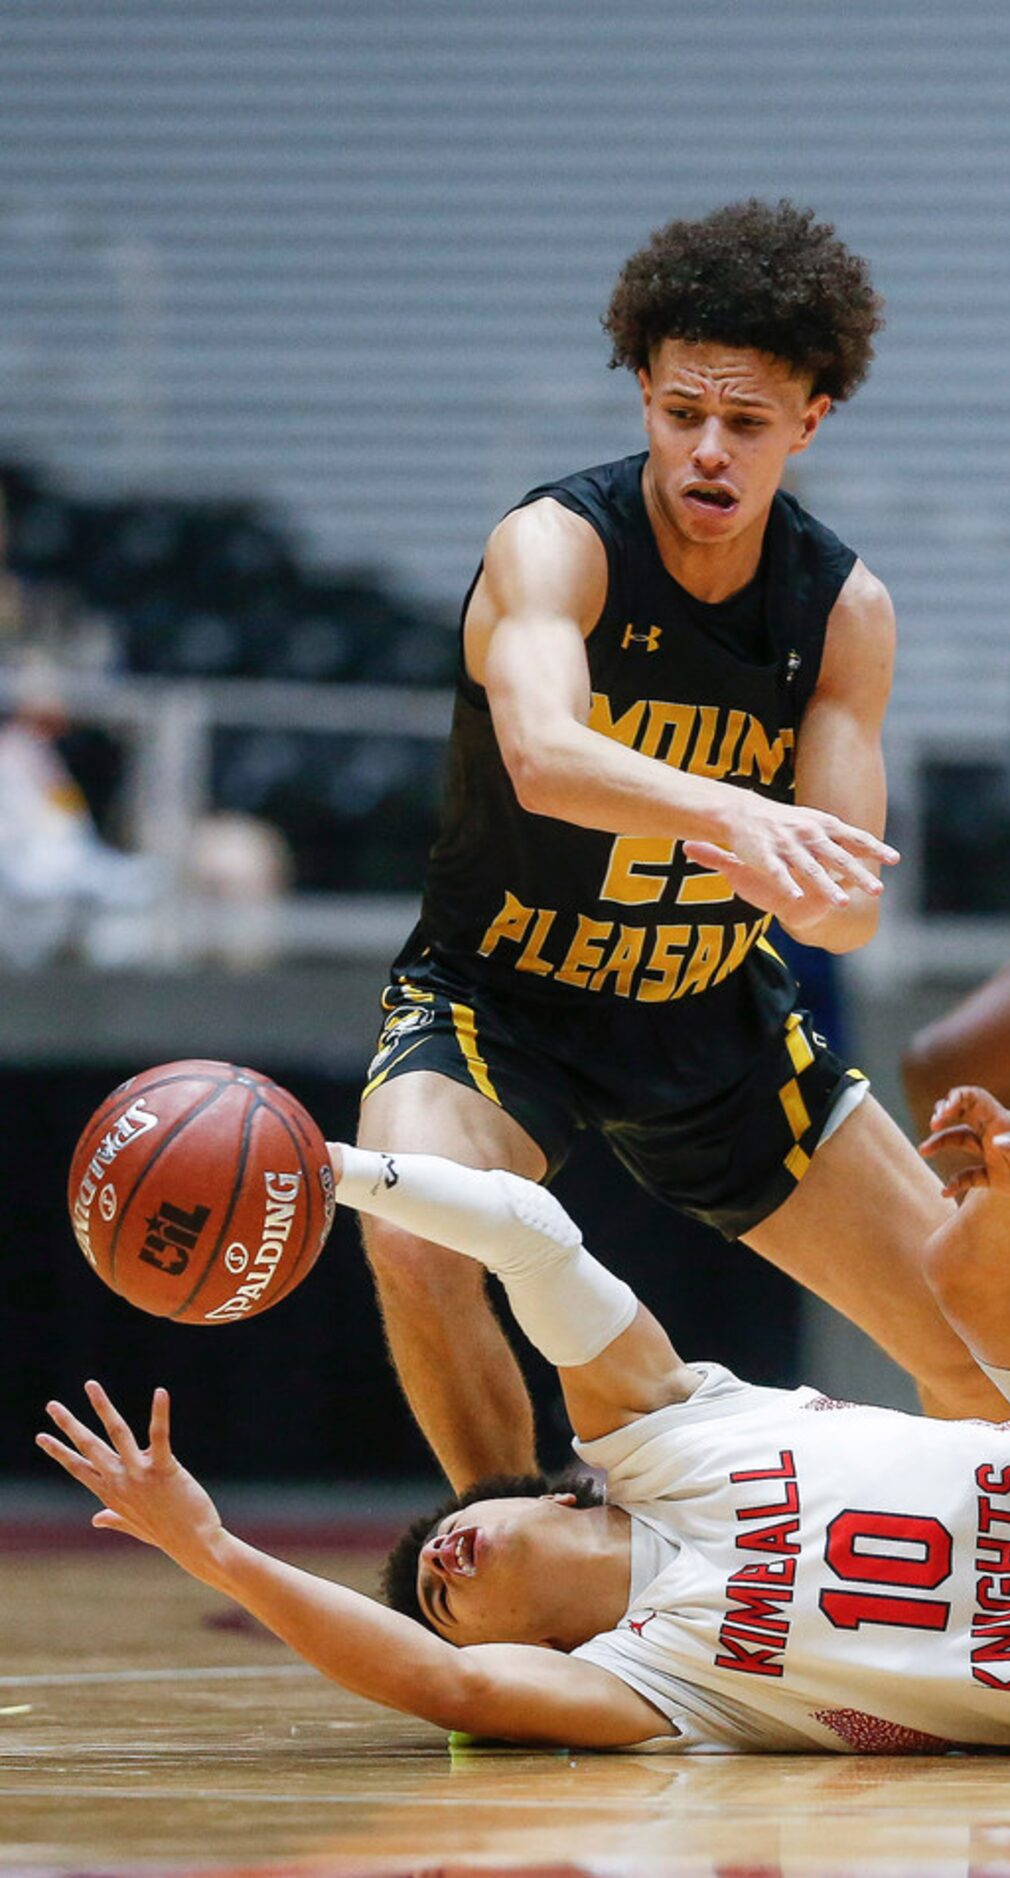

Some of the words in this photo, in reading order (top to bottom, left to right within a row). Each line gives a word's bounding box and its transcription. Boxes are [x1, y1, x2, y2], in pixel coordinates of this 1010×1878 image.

[476, 889, 774, 1003] PLEASAN
[714, 1449, 801, 1677] KIMBALL
[819, 1508, 954, 1632] 10
